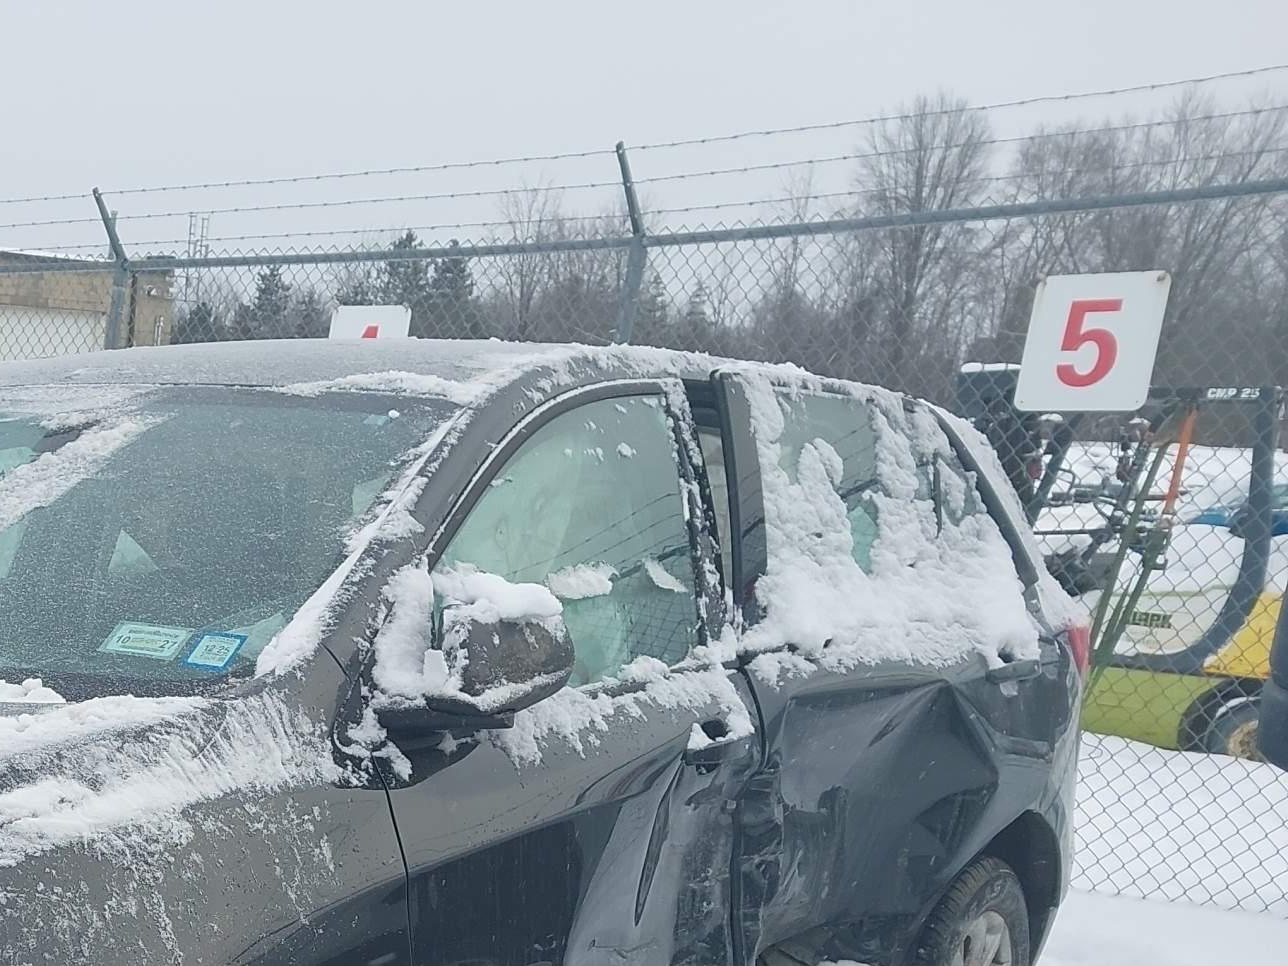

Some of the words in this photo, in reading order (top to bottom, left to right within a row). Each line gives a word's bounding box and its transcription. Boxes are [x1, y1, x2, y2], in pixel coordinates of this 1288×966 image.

[1055, 298, 1124, 388] 5
[116, 635, 131, 644] 10
[159, 639, 178, 650] 27
